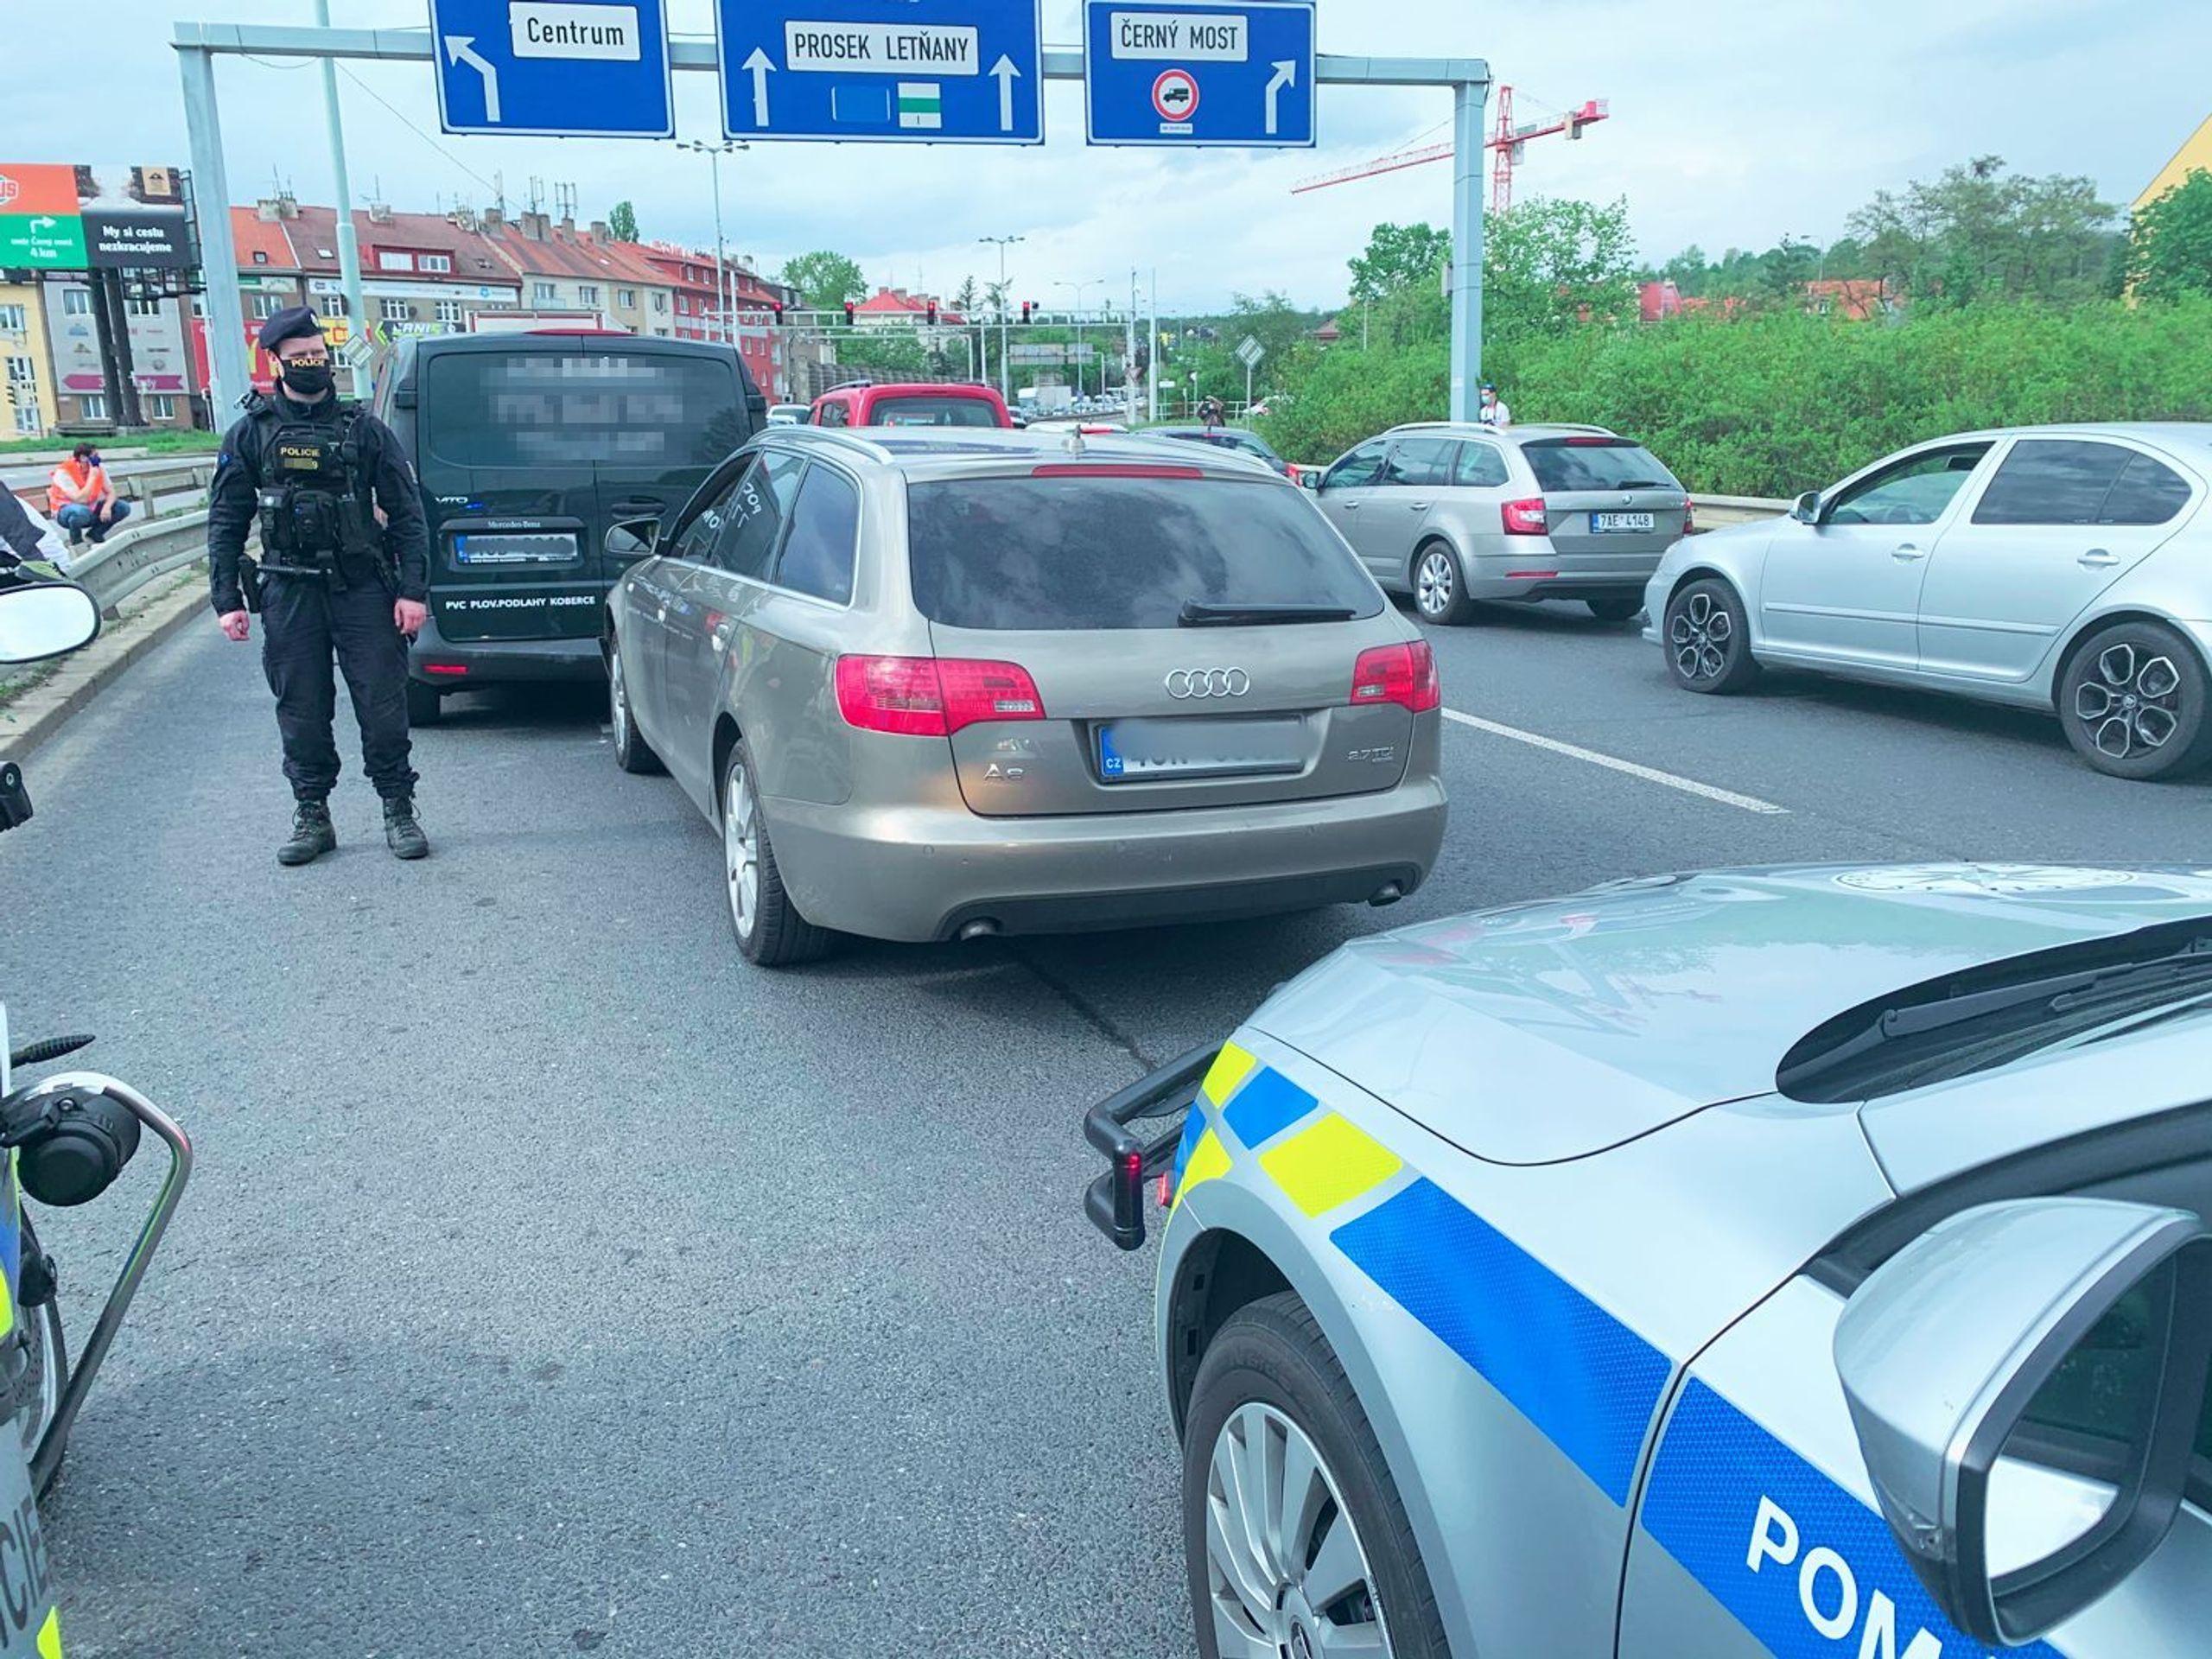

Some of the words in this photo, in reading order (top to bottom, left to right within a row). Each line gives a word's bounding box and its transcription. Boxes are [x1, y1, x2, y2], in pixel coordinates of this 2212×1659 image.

[527, 17, 624, 46] Centrum
[1122, 18, 1179, 48] ČERNÝ
[1190, 26, 1238, 50] MOST
[795, 33, 871, 60] PROSEK
[886, 31, 969, 62] LETŇANY
[103, 226, 119, 238] My
[123, 226, 133, 237] si
[136, 227, 164, 238] cestu
[99, 240, 172, 254] nezkracujeme
[280, 447, 320, 456] POLICIE
[435, 496, 468, 505] VITO
[487, 520, 541, 529] Mercedes-Benz
[1601, 515, 1618, 526] 7AE
[1626, 515, 1649, 526] 4148
[445, 601, 467, 610] PVC
[469, 598, 546, 609] PLOV.PODLAHY
[550, 595, 596, 606] KOBERCE
[1106, 758, 1122, 769] CZ
